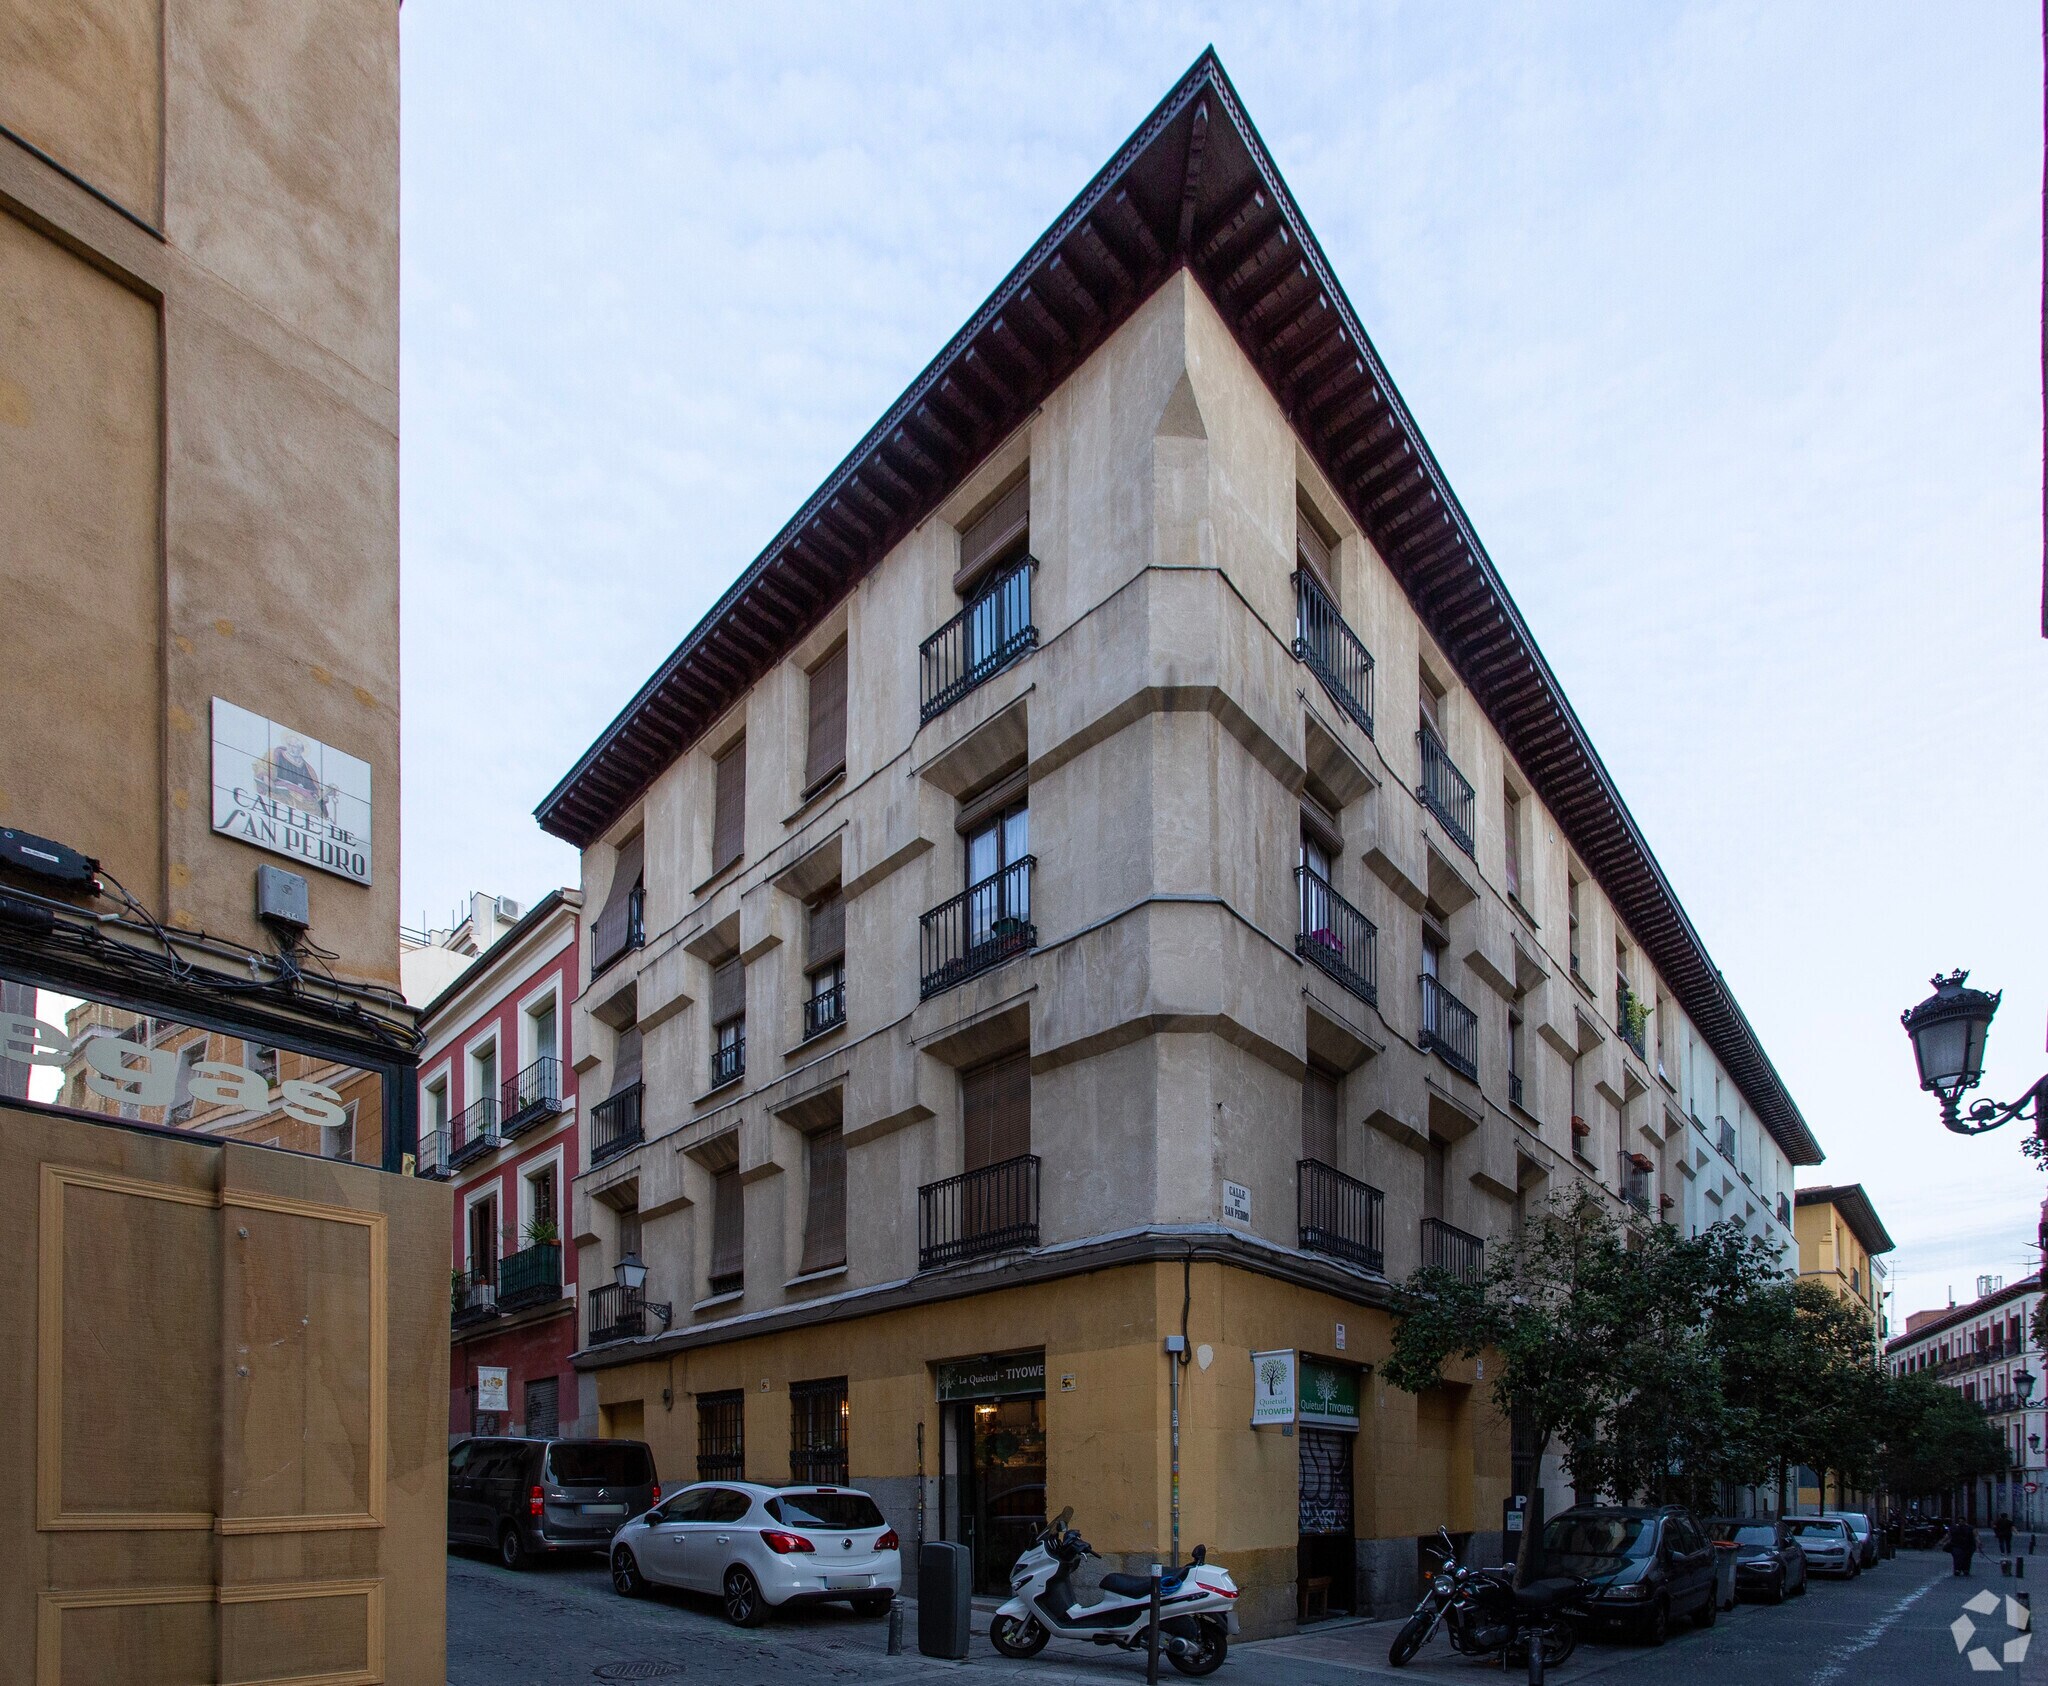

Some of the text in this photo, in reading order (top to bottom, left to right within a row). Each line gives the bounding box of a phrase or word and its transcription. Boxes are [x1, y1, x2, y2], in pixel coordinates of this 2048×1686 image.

[232, 787, 357, 847] CALLE DE
[215, 809, 366, 877] SAN PEDRO
[1229, 1186, 1246, 1200] CALLE
[1234, 1199, 1240, 1208] DE
[1224, 1205, 1250, 1222] SAN PEDRO
[959, 1375, 967, 1385] La
[969, 1371, 998, 1386] Quietud
[1006, 1365, 1046, 1379] TIYOWE
[1259, 1396, 1287, 1407] Quietud
[1300, 1399, 1354, 1414] Quietud TIYOWEH
[1257, 1407, 1292, 1416] TIYOWEH
[1515, 1495, 1527, 1509] P
